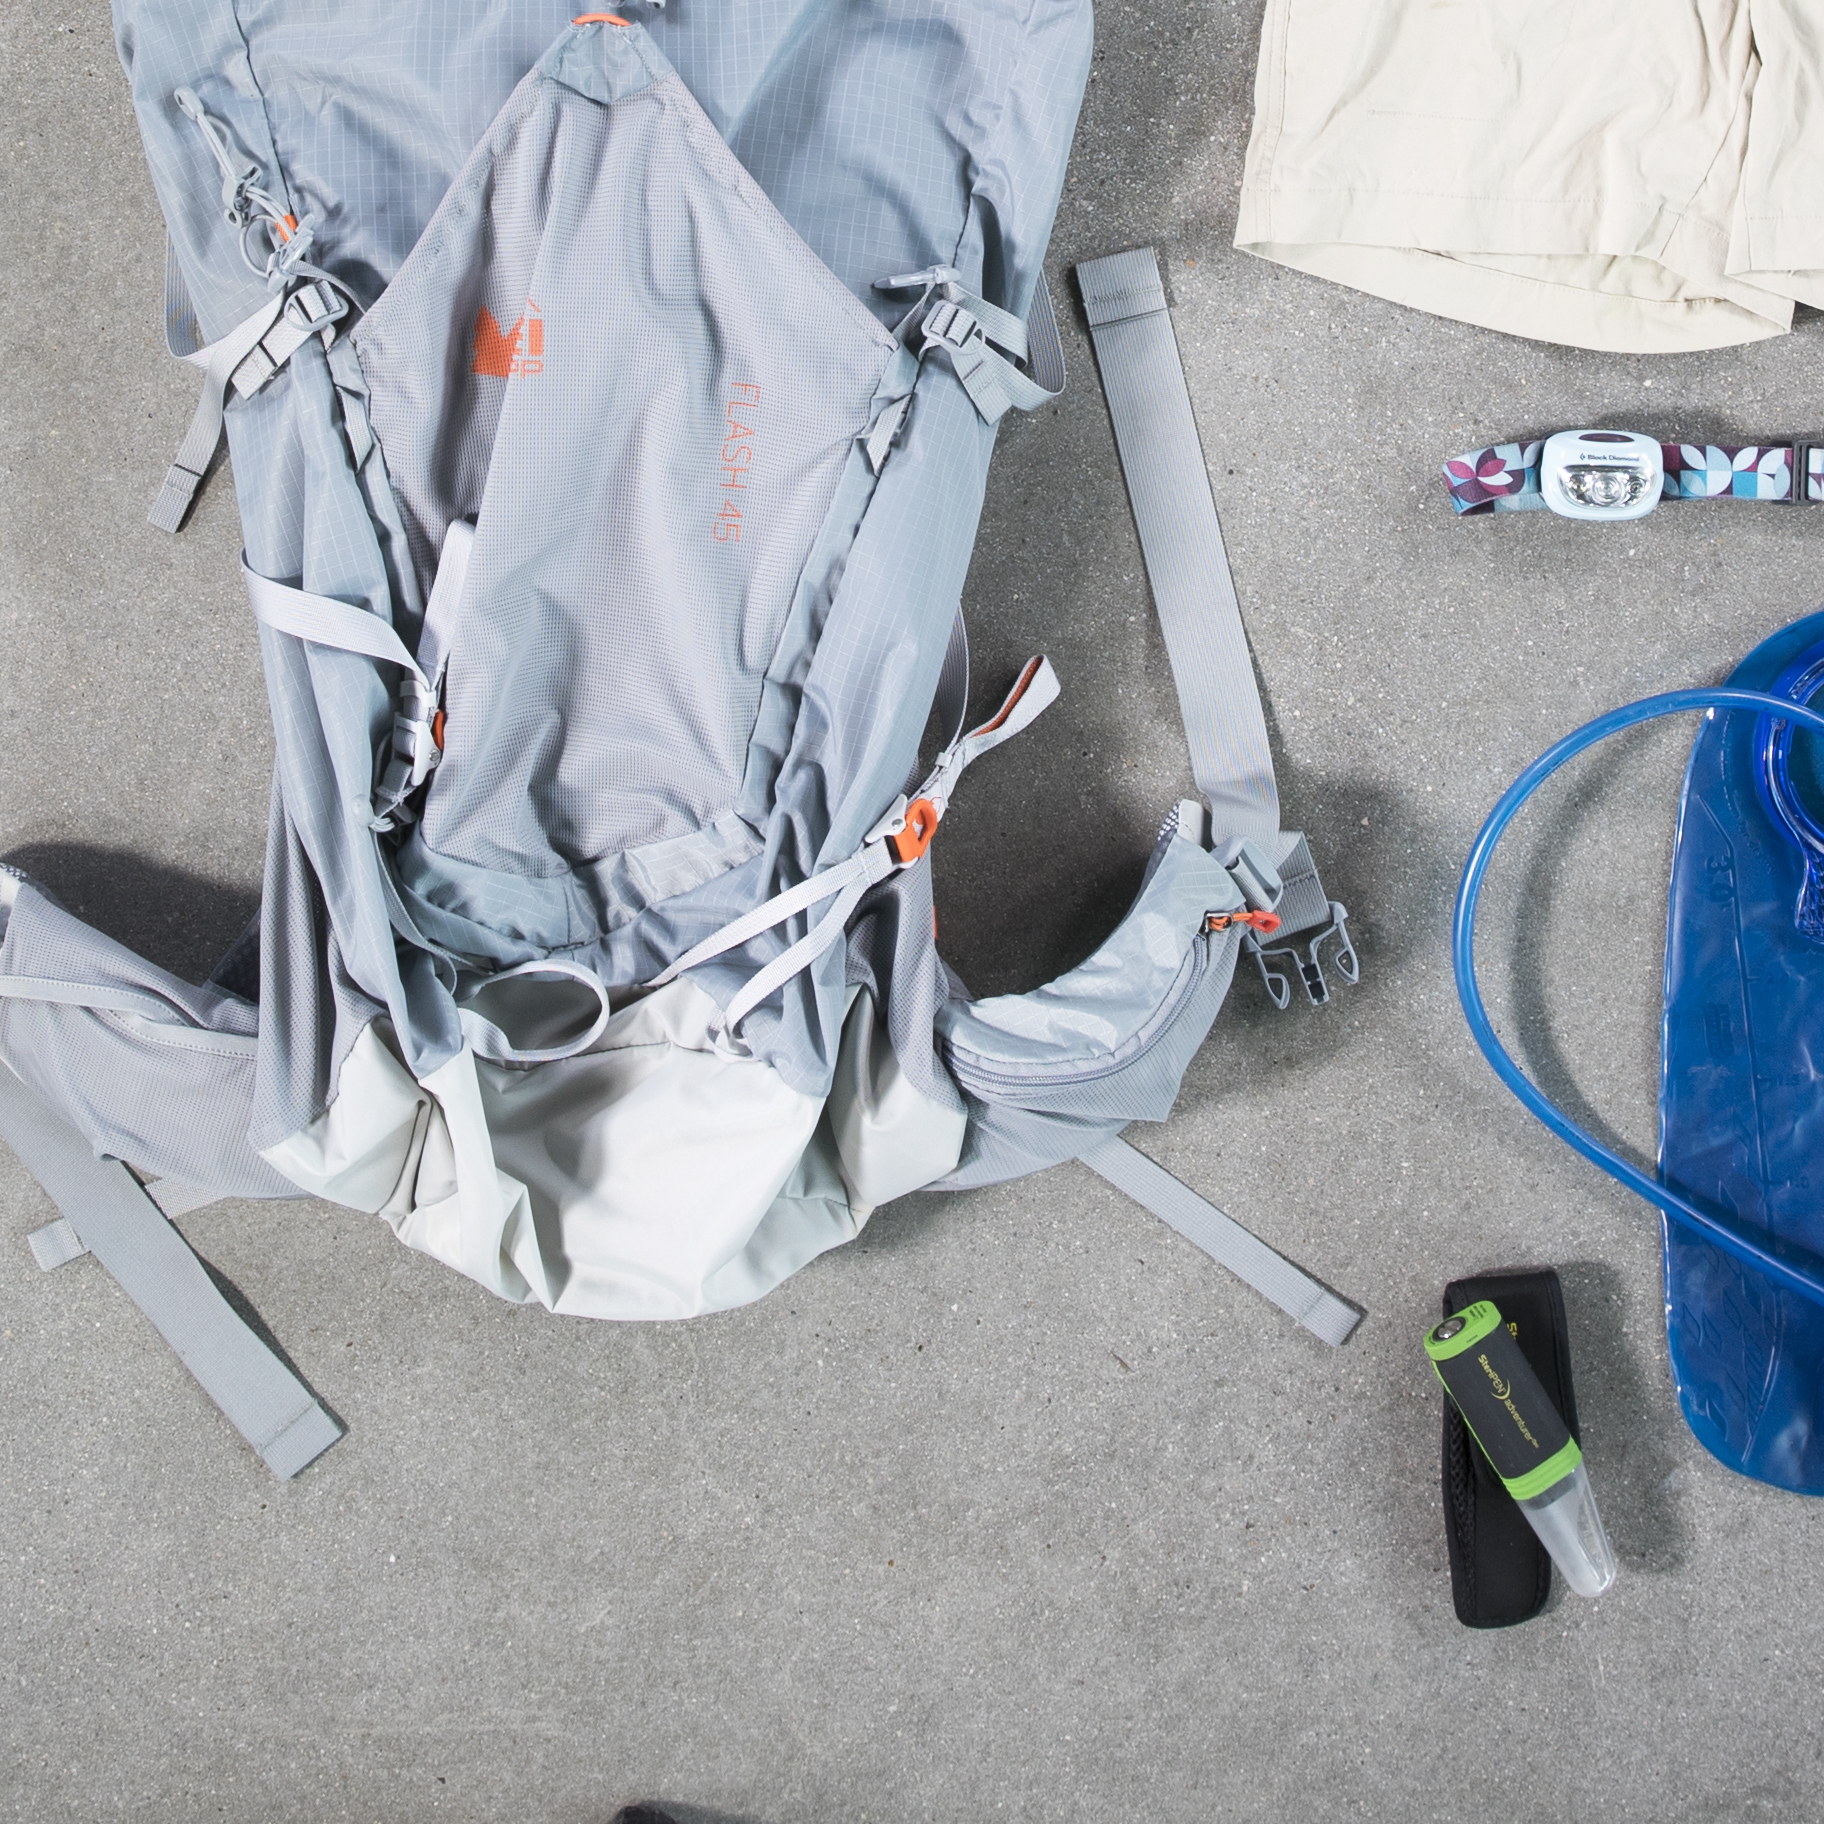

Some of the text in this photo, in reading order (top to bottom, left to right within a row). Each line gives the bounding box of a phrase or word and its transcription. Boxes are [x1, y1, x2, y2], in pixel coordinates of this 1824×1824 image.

[713, 381, 761, 543] FLASH 45
[1608, 454, 1640, 462] Diamond
[1476, 1353, 1506, 1395] SteriPEN
